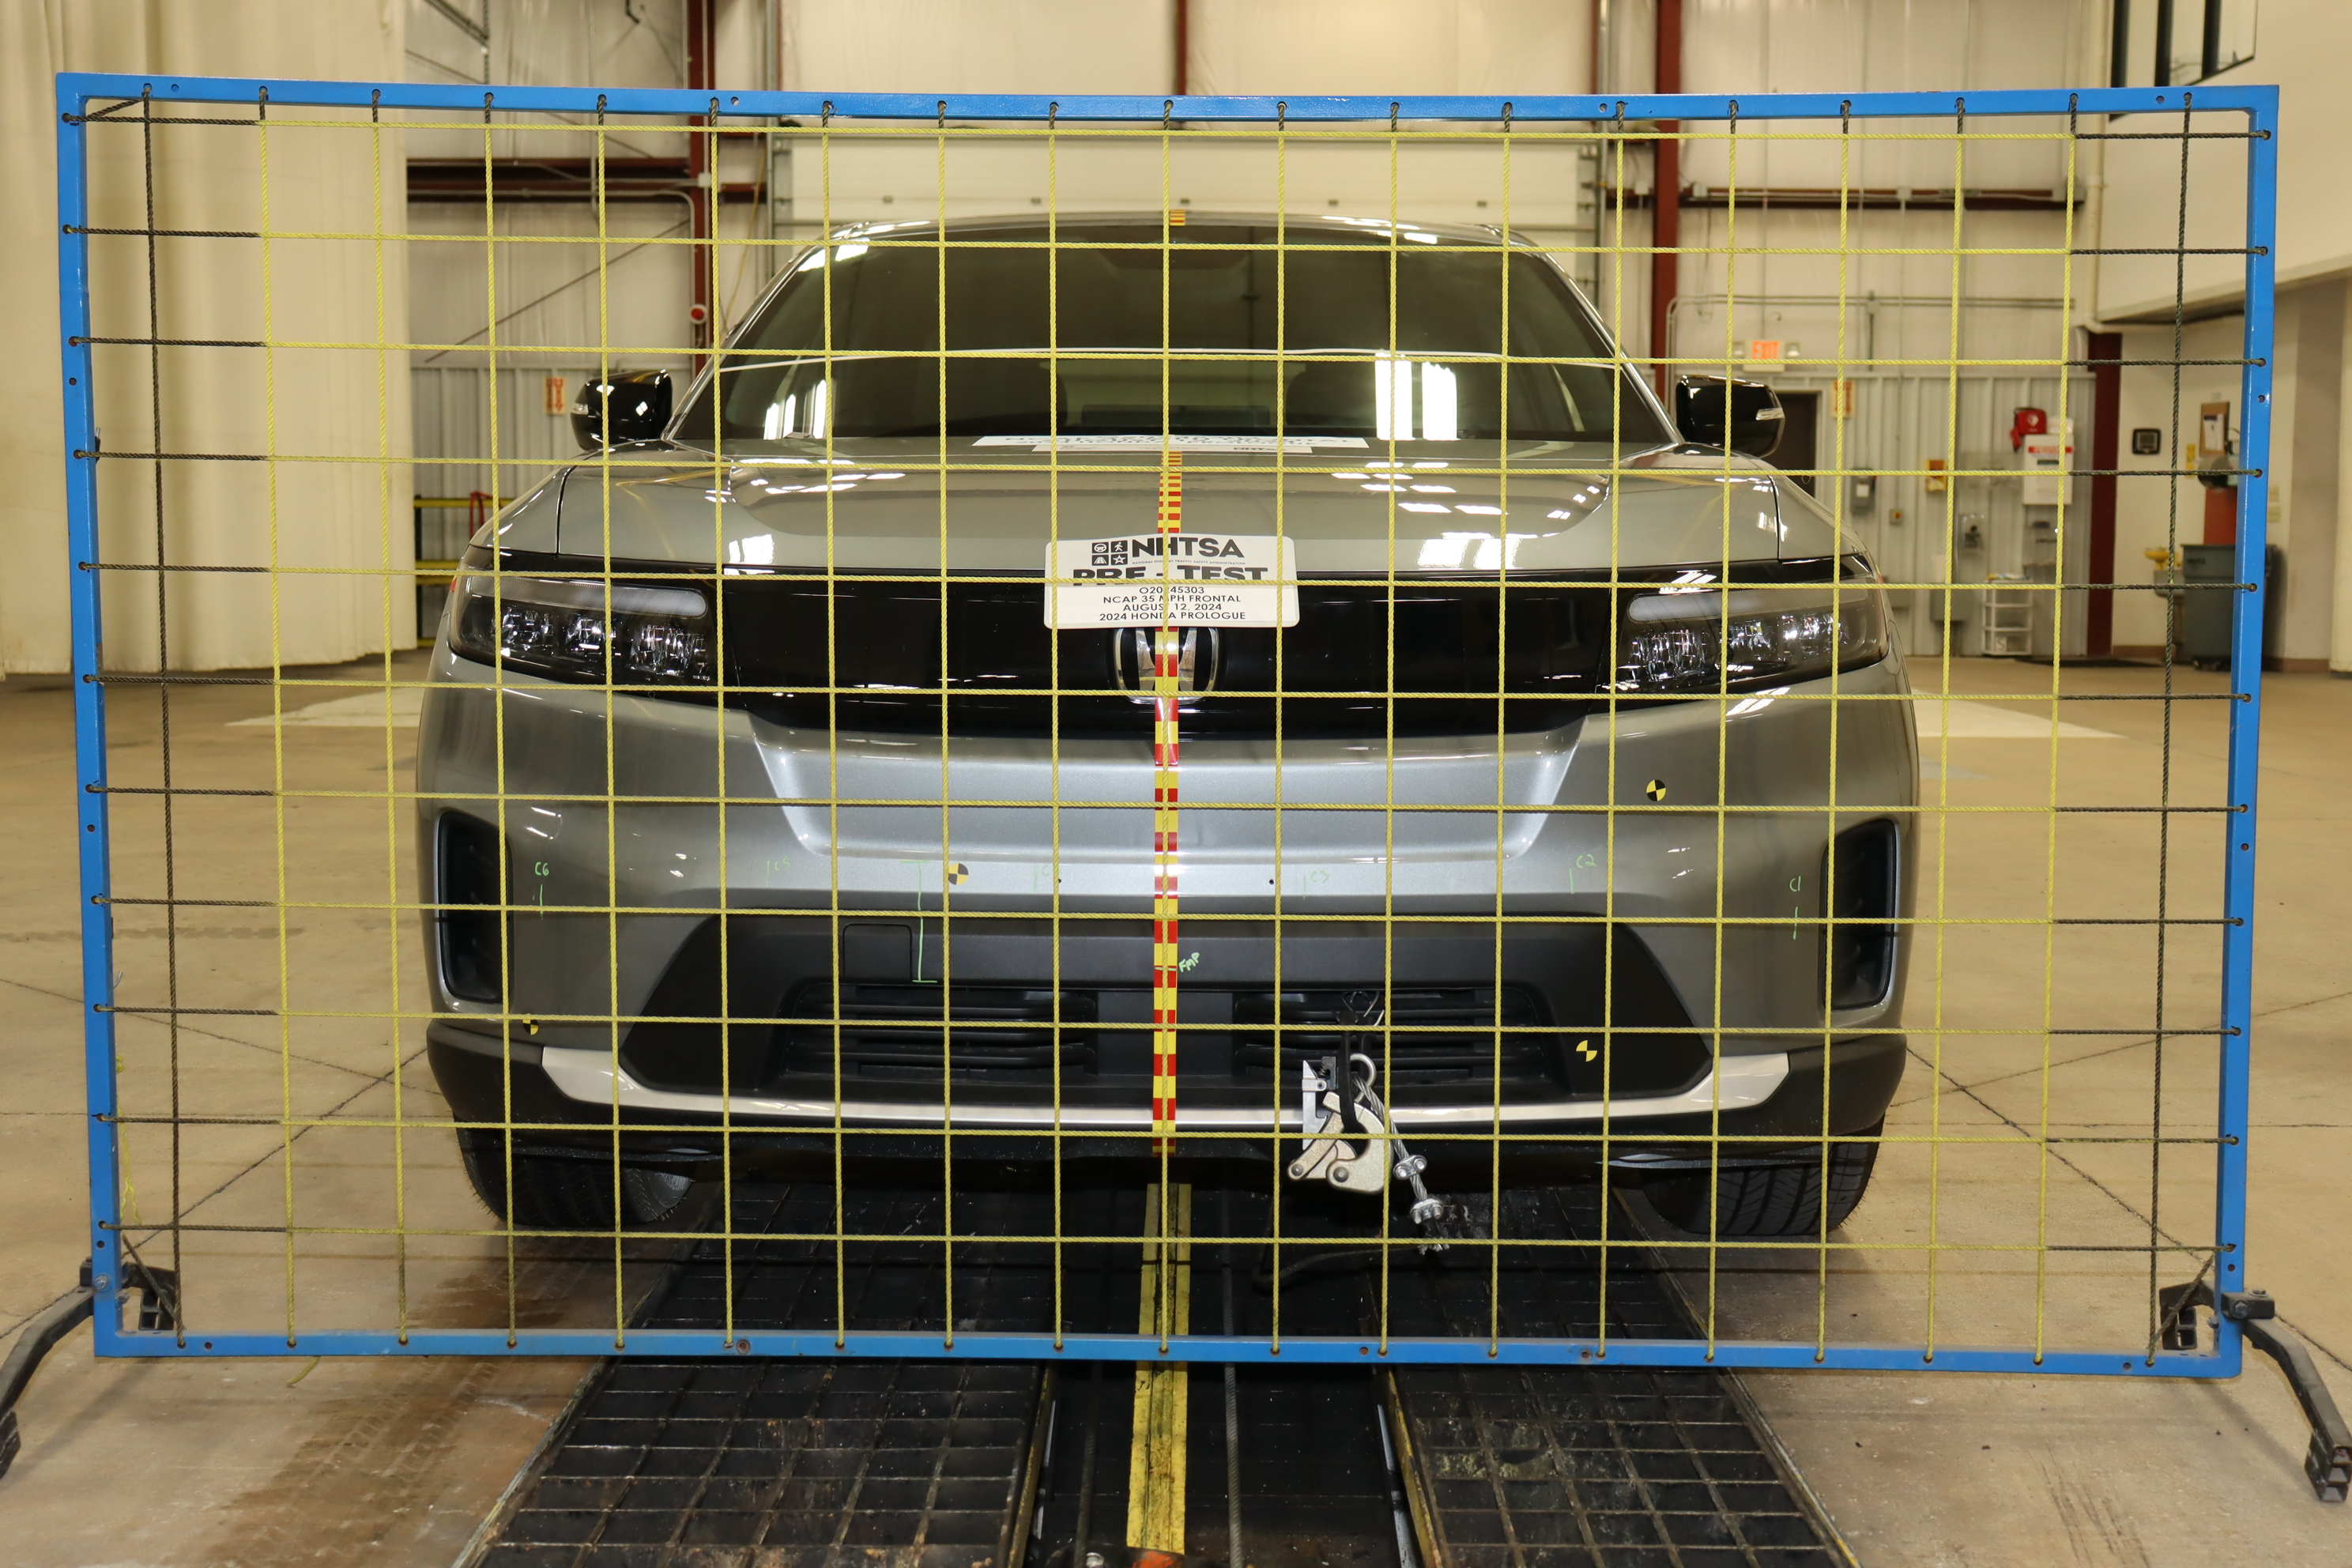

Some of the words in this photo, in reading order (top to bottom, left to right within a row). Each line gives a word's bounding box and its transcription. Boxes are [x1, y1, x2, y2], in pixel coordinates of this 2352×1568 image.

[1132, 537, 1245, 558] NHTSA
[1072, 566, 1146, 586] PRE
[1177, 564, 1268, 581] TEST
[1122, 603, 1169, 612] AUGUS
[1174, 603, 1190, 612] 12,
[534, 861, 549, 876] C6
[1576, 854, 1599, 869] C2
